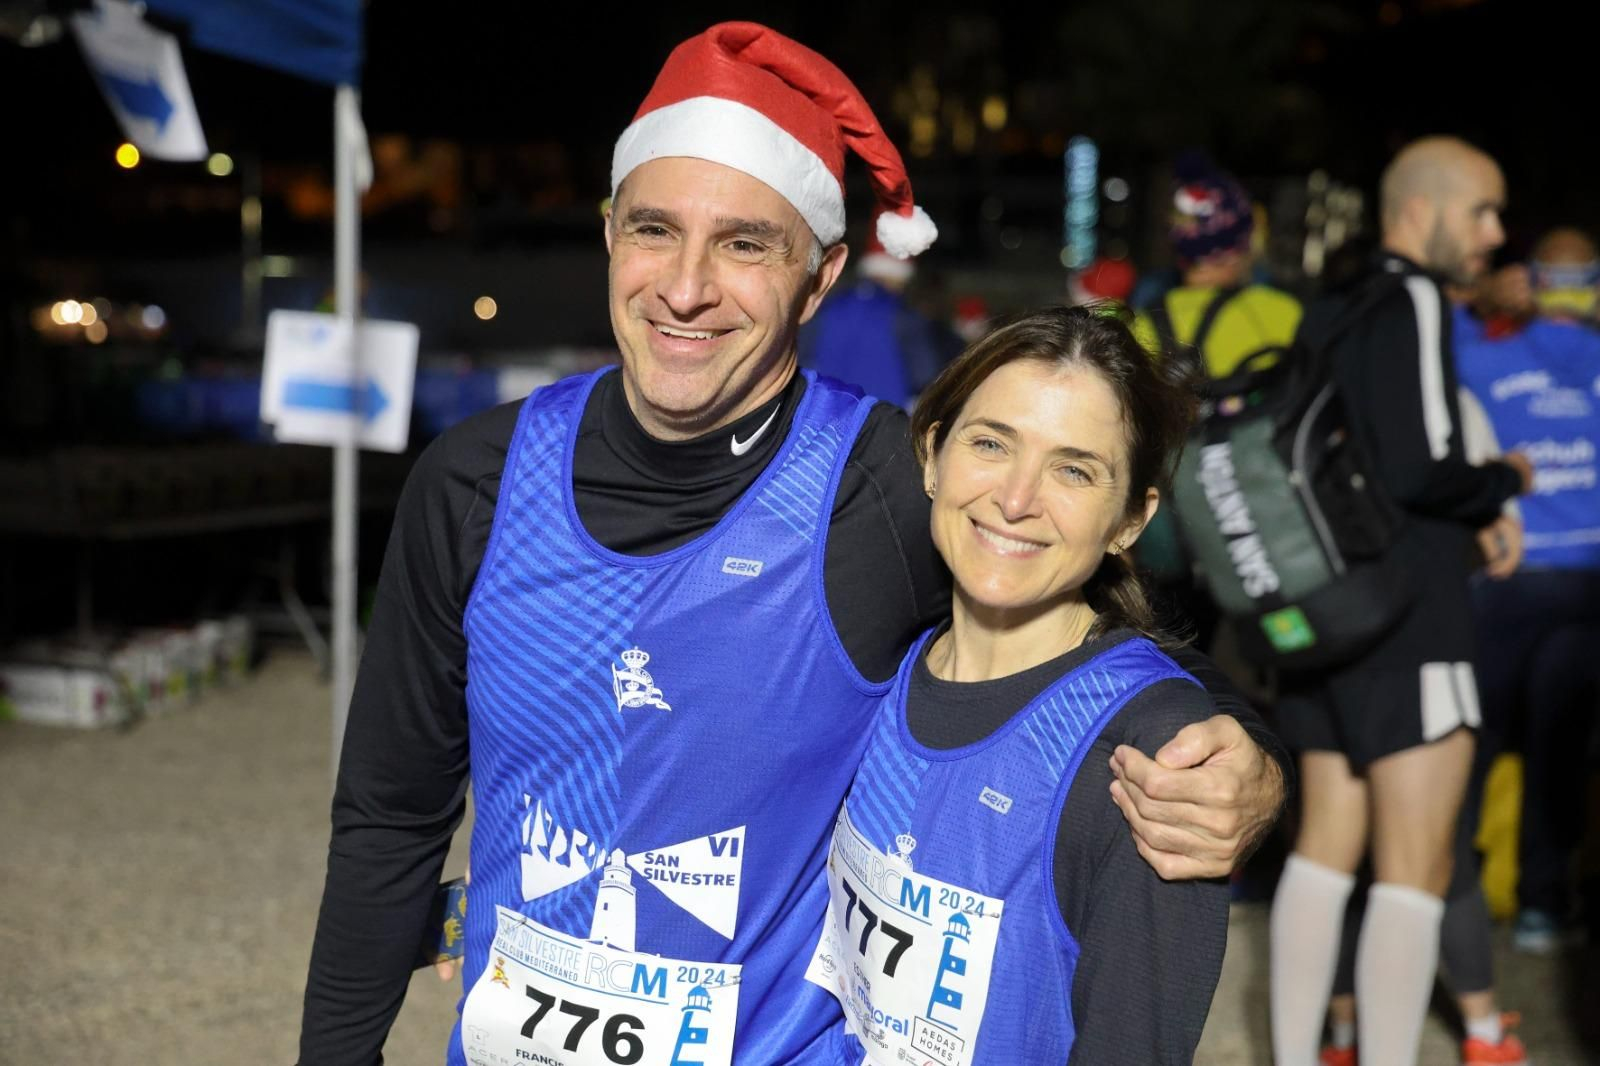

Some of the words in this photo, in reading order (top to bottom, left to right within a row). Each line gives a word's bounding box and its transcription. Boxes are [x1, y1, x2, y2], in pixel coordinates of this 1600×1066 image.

[727, 562, 758, 572] 42K
[1226, 534, 1280, 597] SAN
[984, 793, 1008, 809] 42K
[708, 836, 739, 857] VI
[644, 852, 680, 868] SAN
[643, 868, 736, 886] SILVESTRE
[870, 855, 931, 918] RCM
[842, 876, 914, 978] 777
[519, 929, 582, 970] SILVESTRE
[584, 952, 668, 999] RCM
[520, 984, 646, 1066] 776
[919, 1036, 954, 1062] HOMES
[922, 1027, 957, 1052] AEDAS
